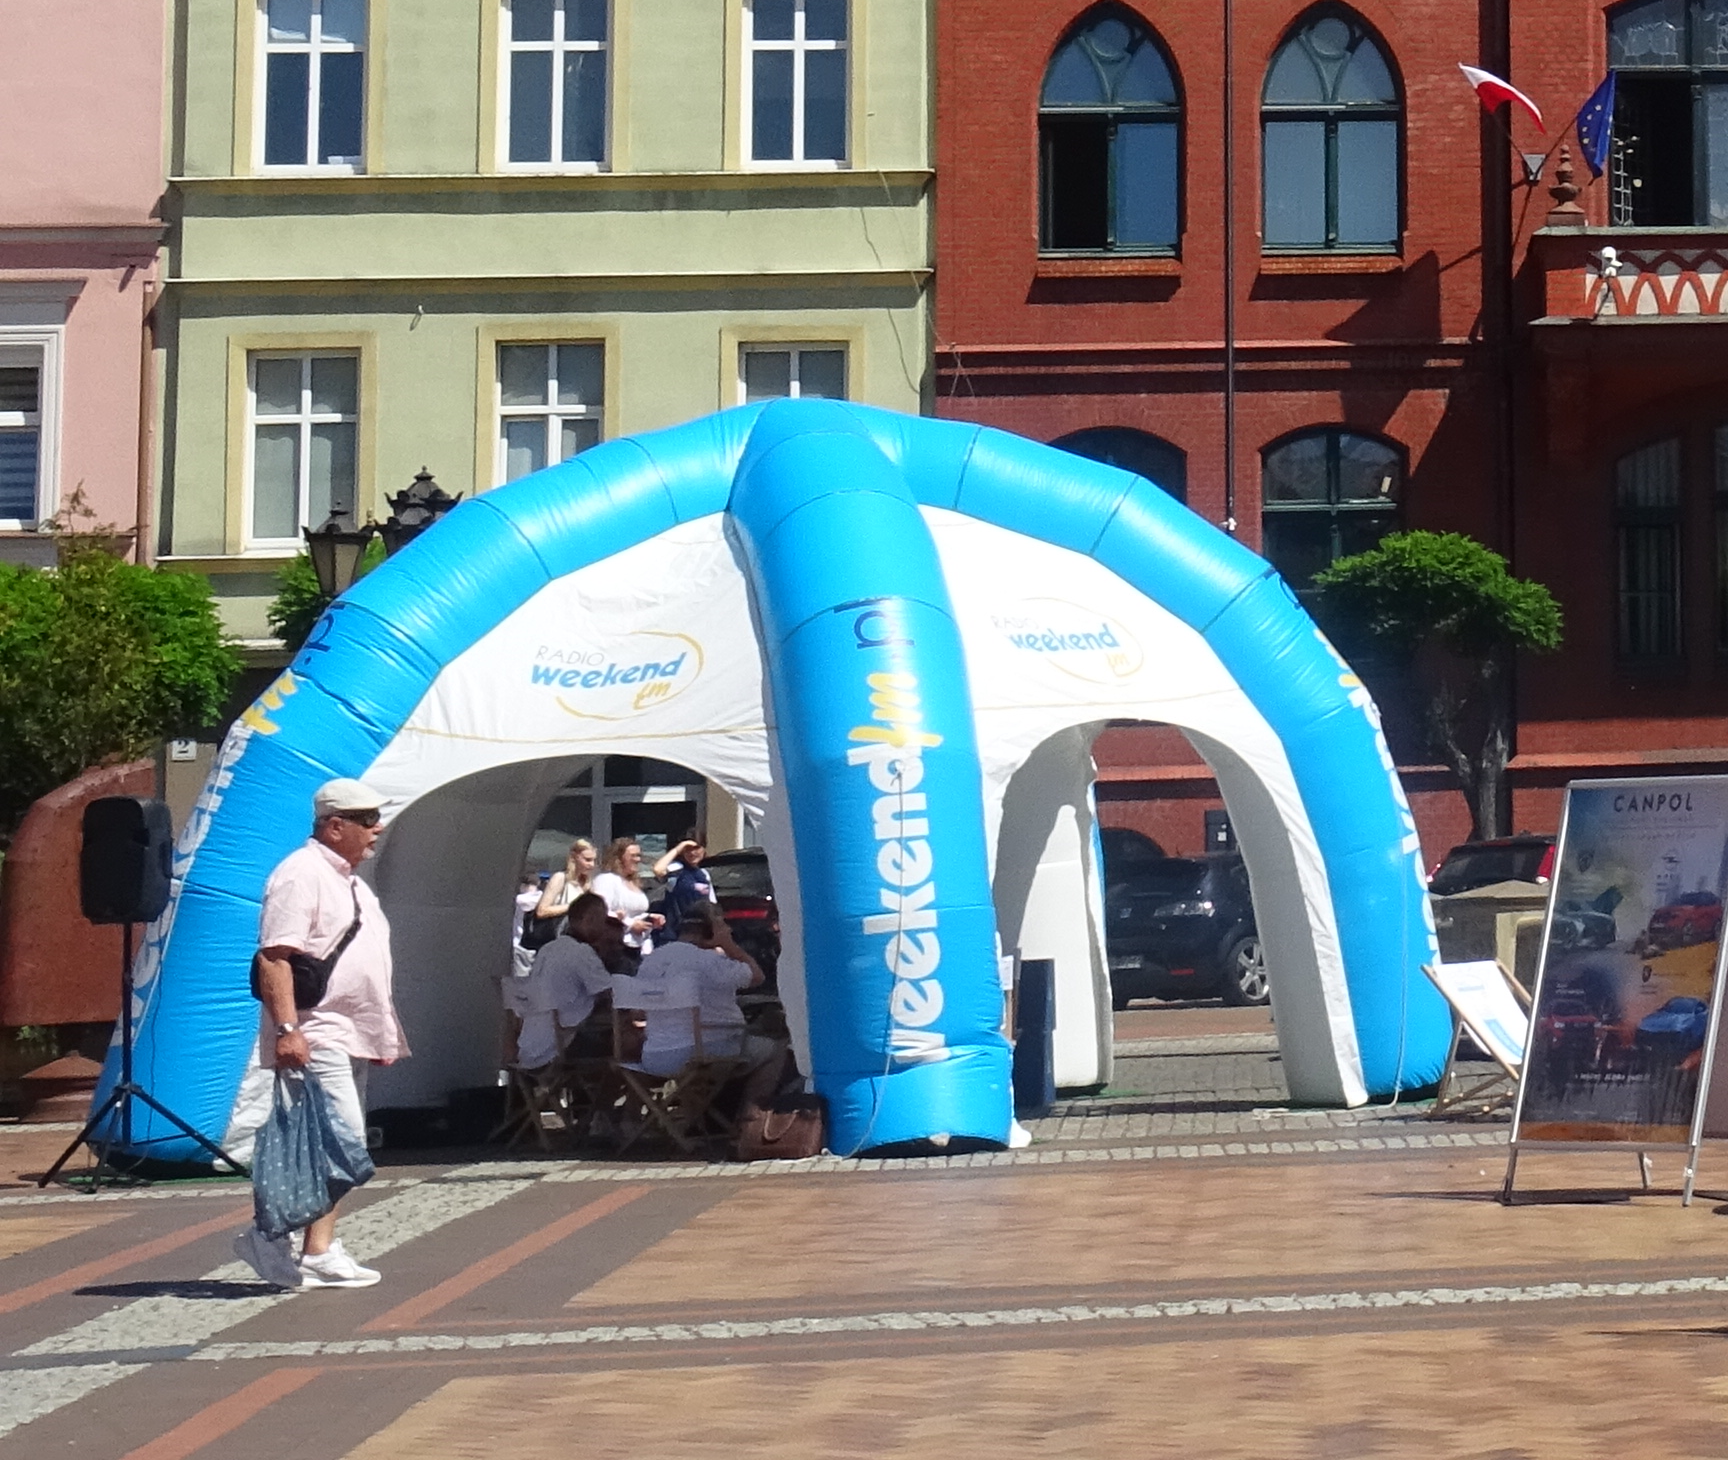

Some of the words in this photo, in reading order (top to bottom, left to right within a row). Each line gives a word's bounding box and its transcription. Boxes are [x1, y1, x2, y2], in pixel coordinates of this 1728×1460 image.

[1004, 622, 1121, 652] weekend
[535, 645, 605, 666] RADIO
[530, 651, 688, 689] weekend
[1612, 791, 1694, 814] CANPOL
